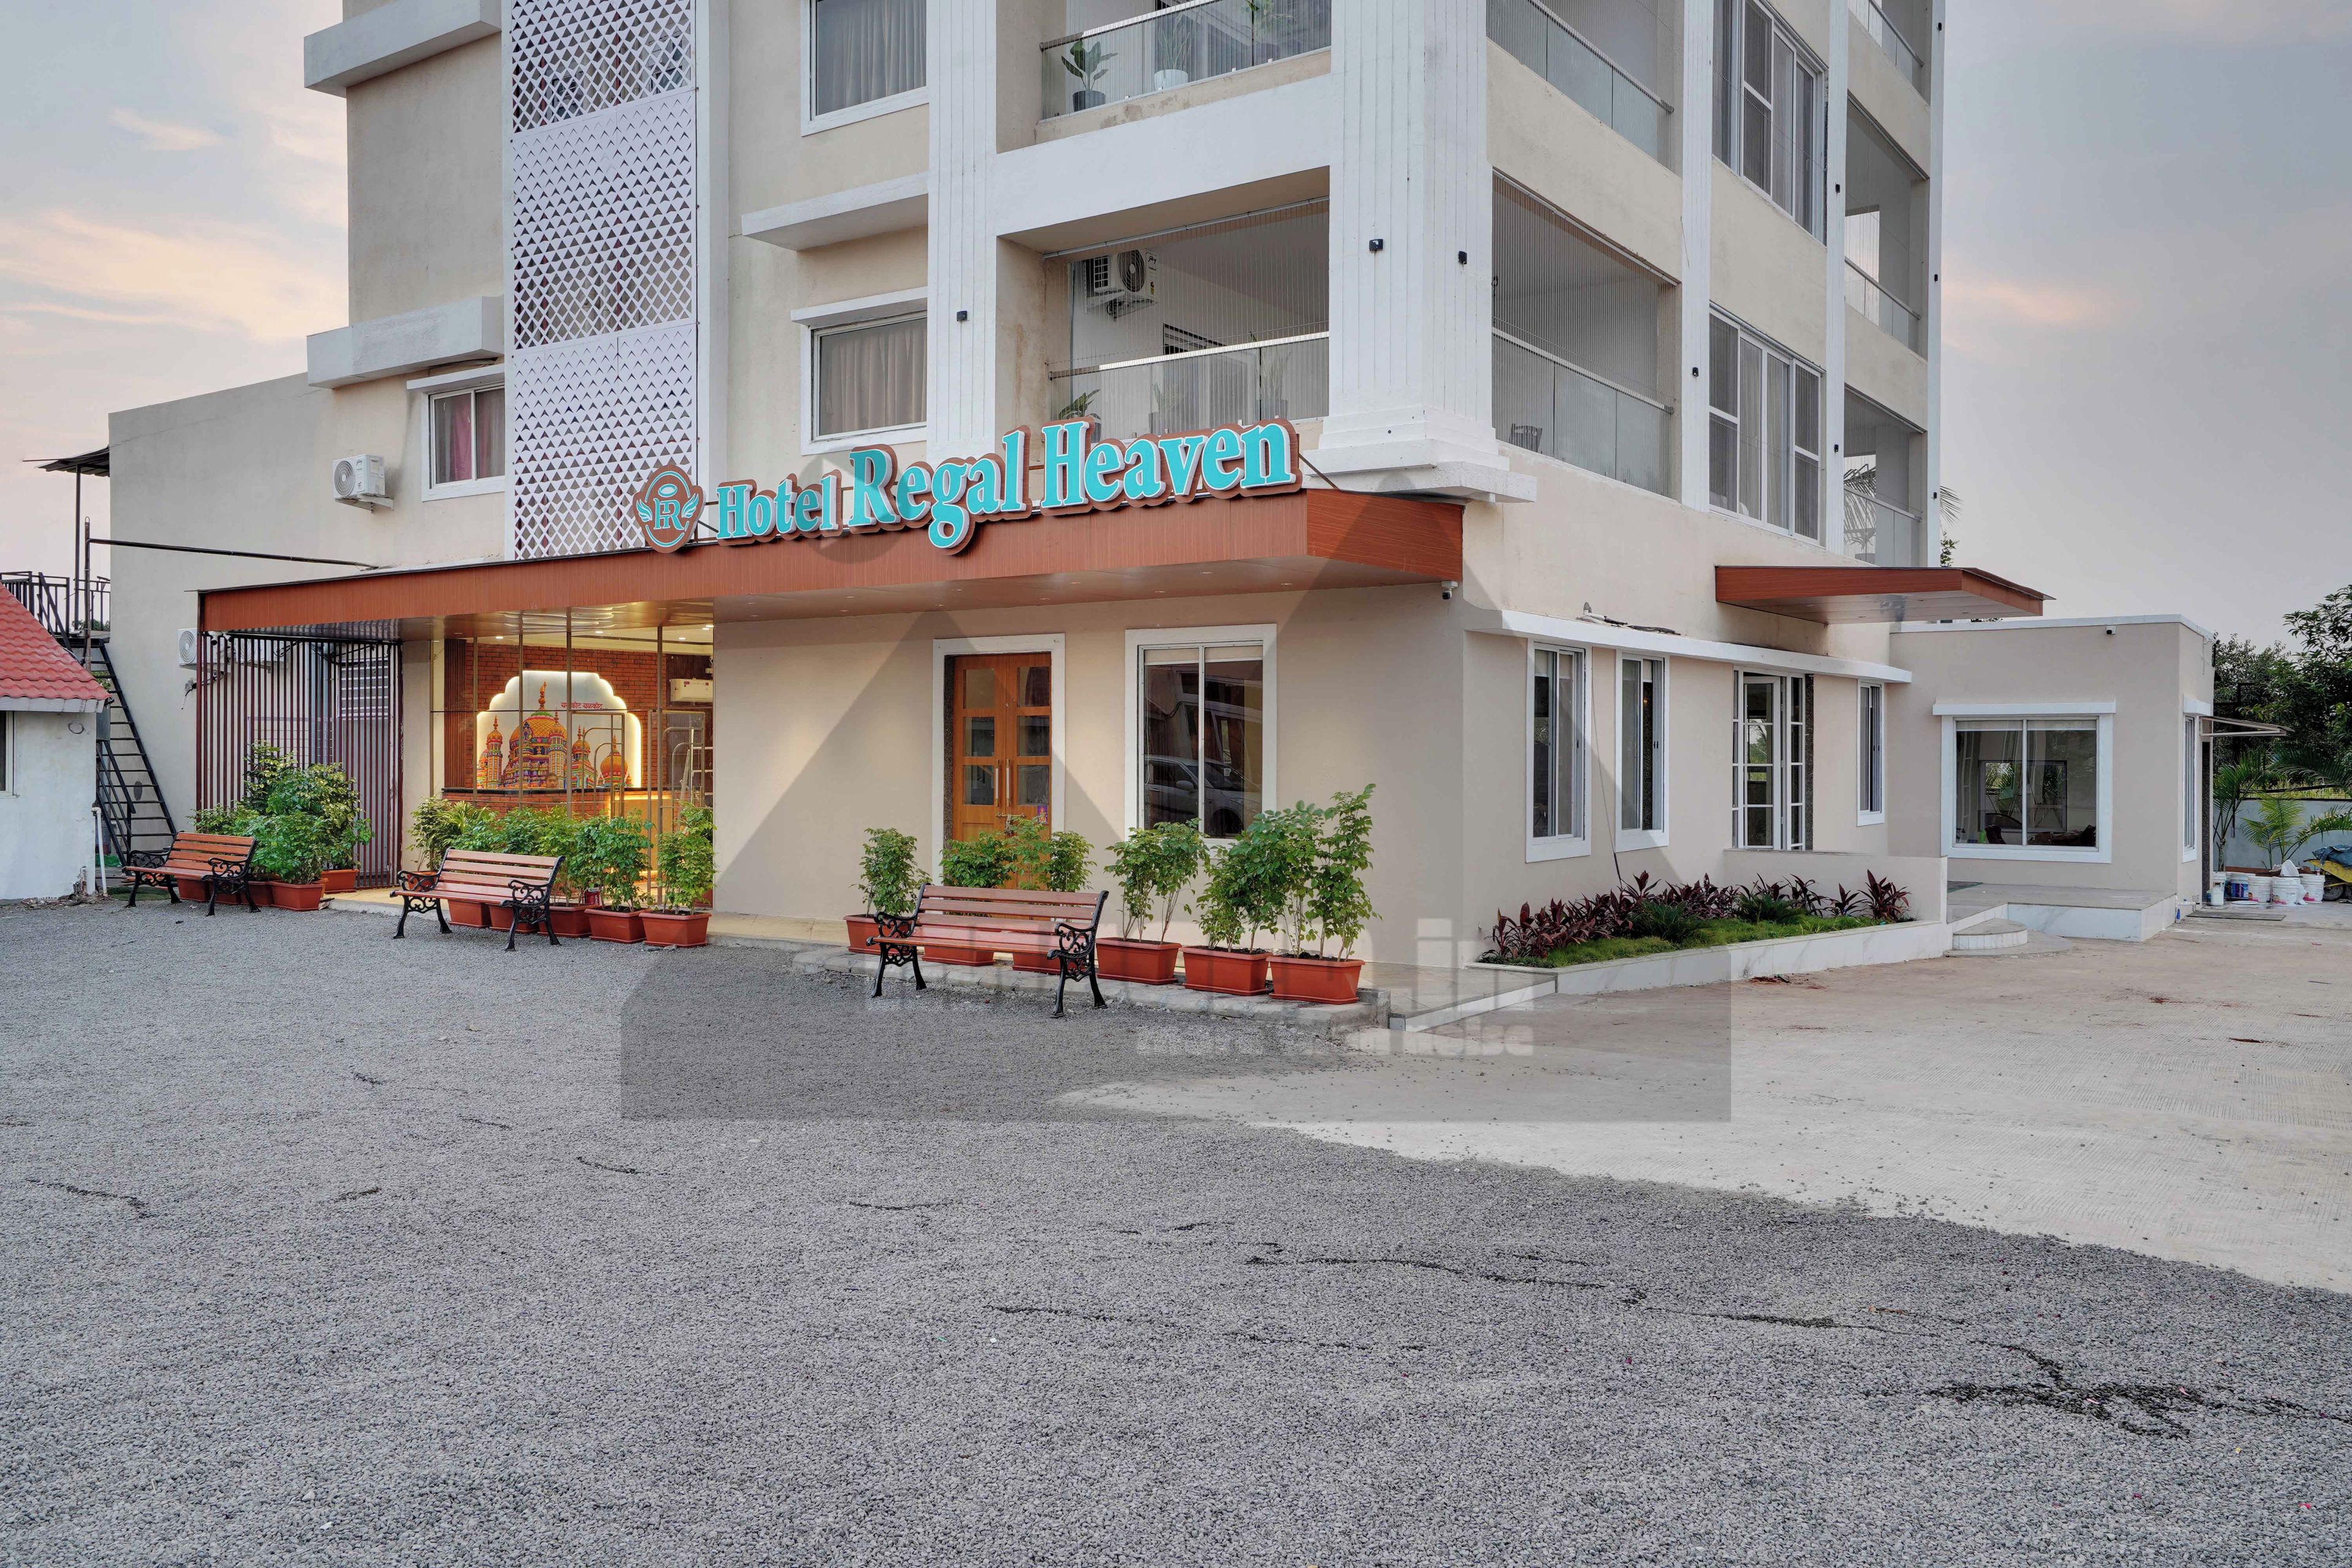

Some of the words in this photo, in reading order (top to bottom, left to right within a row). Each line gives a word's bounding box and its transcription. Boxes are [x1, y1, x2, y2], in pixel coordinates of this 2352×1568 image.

[716, 474, 837, 540] Hotel
[848, 426, 1027, 549] Regal
[1042, 420, 1297, 508] Heaven
